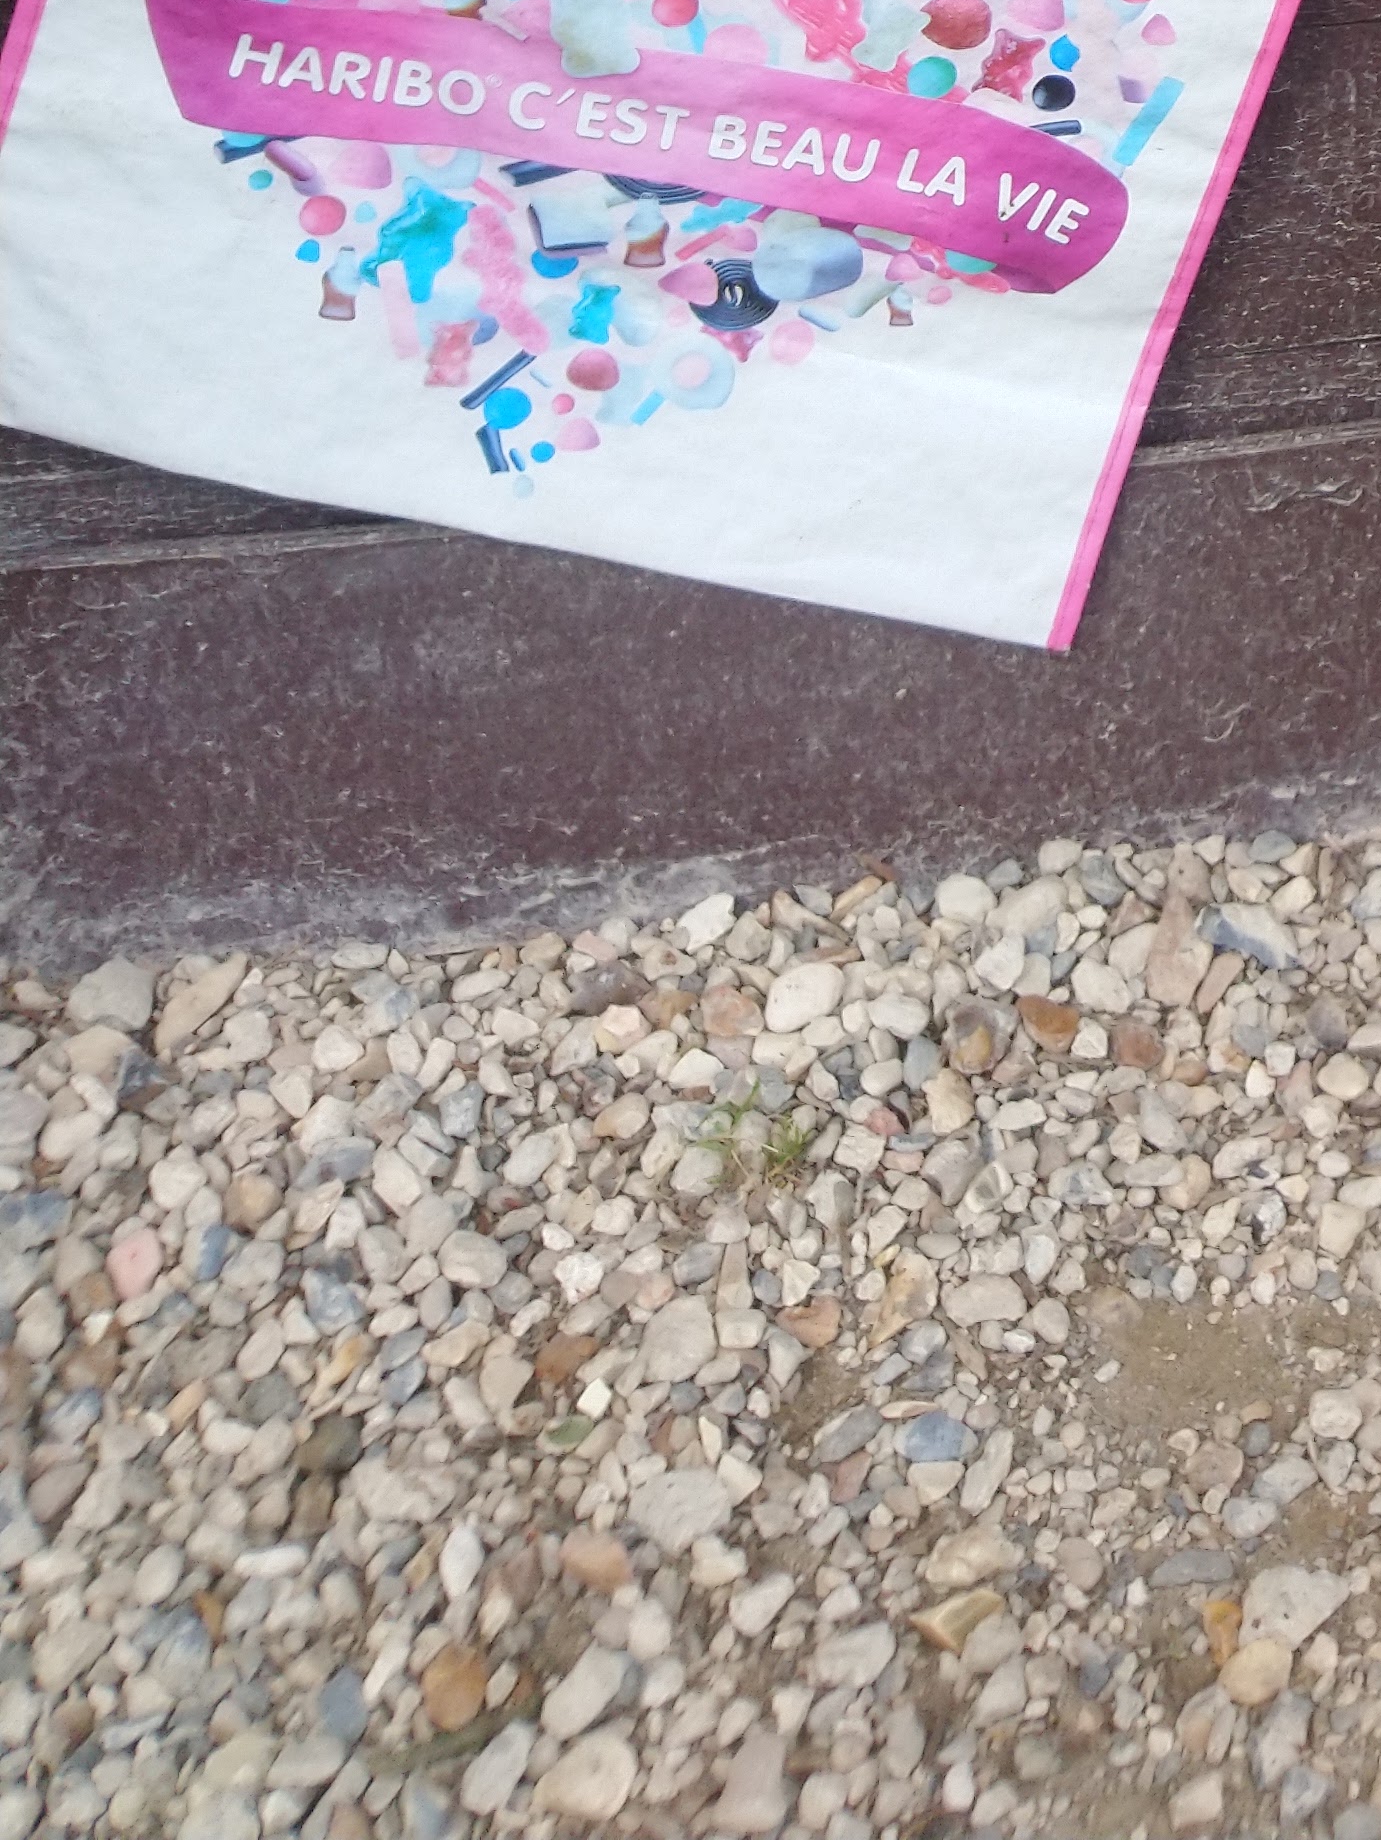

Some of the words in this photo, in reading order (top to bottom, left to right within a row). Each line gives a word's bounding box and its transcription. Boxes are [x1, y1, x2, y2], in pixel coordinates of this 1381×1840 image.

[228, 33, 487, 116] HARIBO
[508, 81, 691, 150] C'EST
[707, 113, 881, 183] BEAU
[896, 148, 966, 207] LA
[997, 172, 1091, 246] VIE
